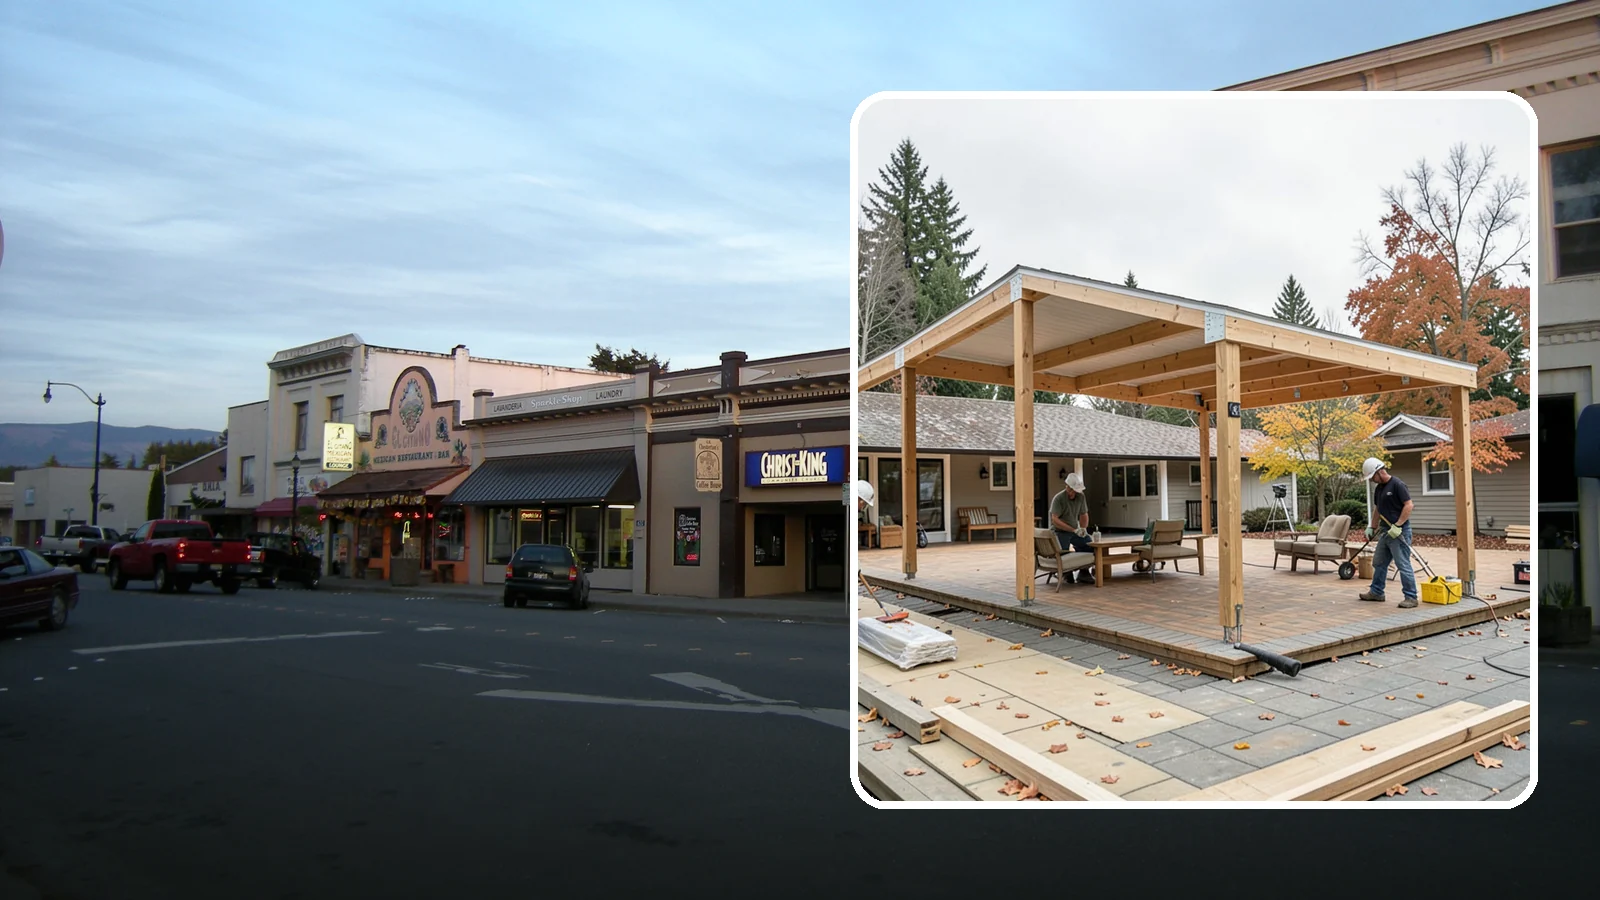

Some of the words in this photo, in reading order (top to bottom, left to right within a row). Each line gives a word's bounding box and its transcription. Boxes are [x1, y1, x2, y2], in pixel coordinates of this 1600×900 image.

[530, 396, 560, 409] Sparkle
[562, 394, 582, 405] Shop
[595, 389, 623, 400] LAUNDRY
[493, 402, 523, 413] LAVANDERIA
[392, 426, 401, 449] EL
[373, 454, 396, 464] MEXICAN
[397, 452, 433, 462] RESTAURANT
[438, 450, 449, 458] BAR
[761, 452, 797, 478] CHRIST
[799, 450, 827, 476] KING
[696, 481, 709, 489] Coffee
[710, 481, 722, 489] House
